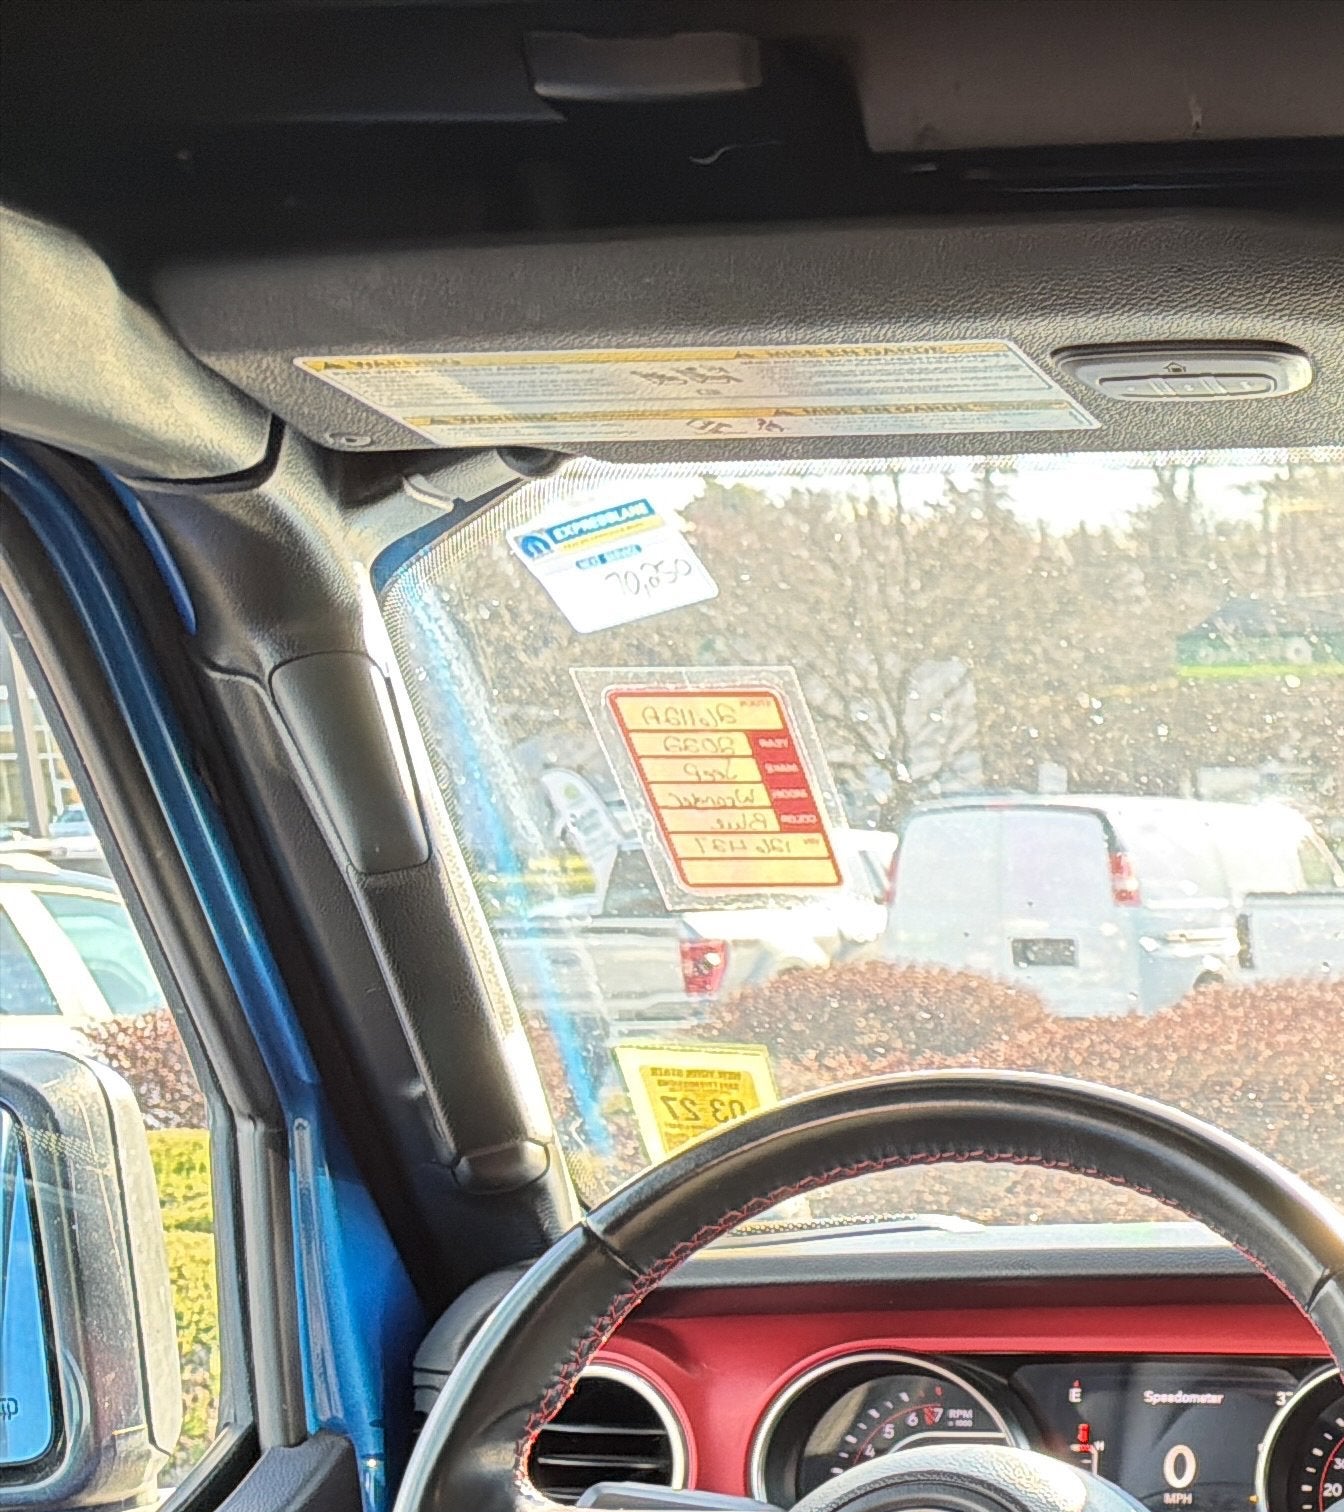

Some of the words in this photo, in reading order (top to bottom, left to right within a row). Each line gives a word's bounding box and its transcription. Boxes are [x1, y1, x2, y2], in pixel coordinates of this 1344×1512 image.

[1068, 1388, 1082, 1403] E
[1144, 1390, 1225, 1406] Speedometer
[906, 1412, 919, 1427] 6
[933, 1408, 944, 1423] 7
[948, 1409, 973, 1419] RPM
[883, 1423, 895, 1439] 5
[865, 1444, 876, 1458] 4
[1163, 1444, 1197, 1489] 0
[1323, 1483, 1343, 1497] 20
[1163, 1493, 1193, 1505] MPH
